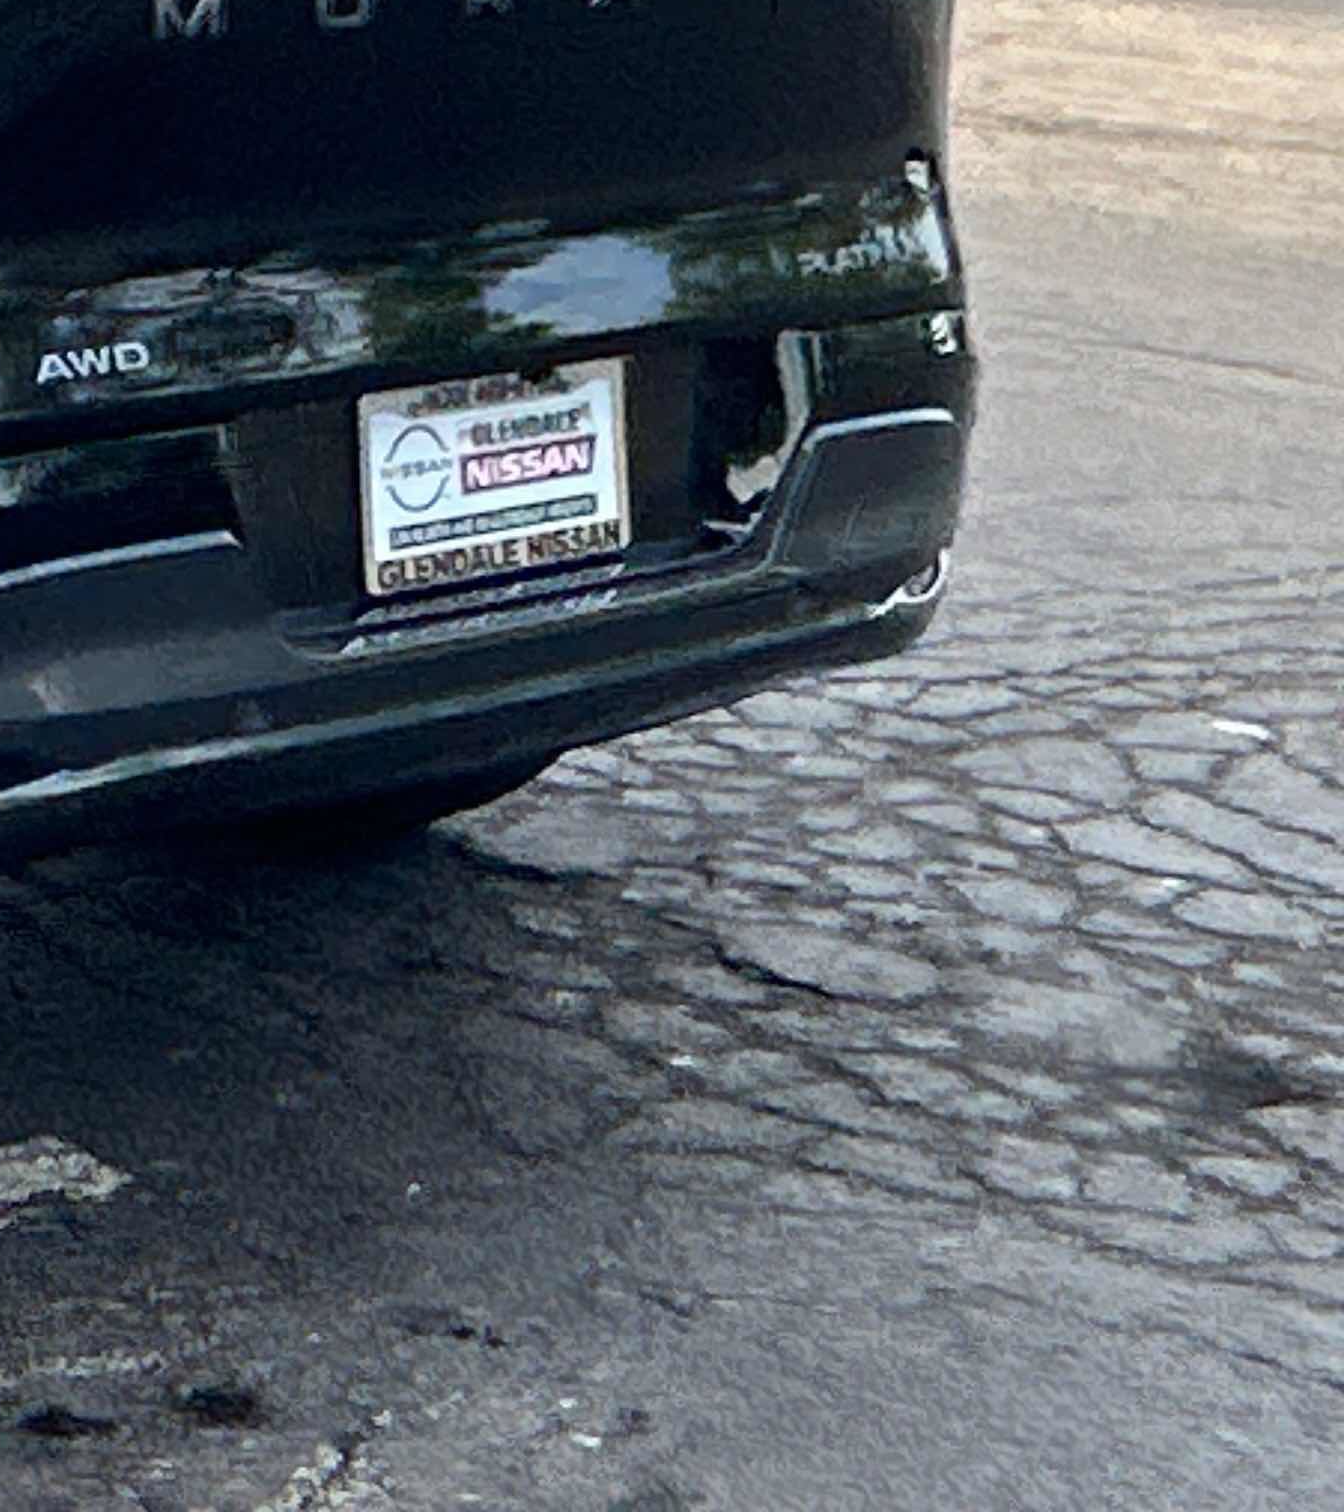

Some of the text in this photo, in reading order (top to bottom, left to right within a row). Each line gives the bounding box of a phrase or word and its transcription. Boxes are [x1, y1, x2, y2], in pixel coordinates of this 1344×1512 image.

[35, 341, 150, 385] AWD
[380, 457, 453, 481] NISSAN
[465, 441, 590, 488] NISSAN
[376, 537, 521, 590] GLENDALE
[525, 519, 621, 563] NISSAN
